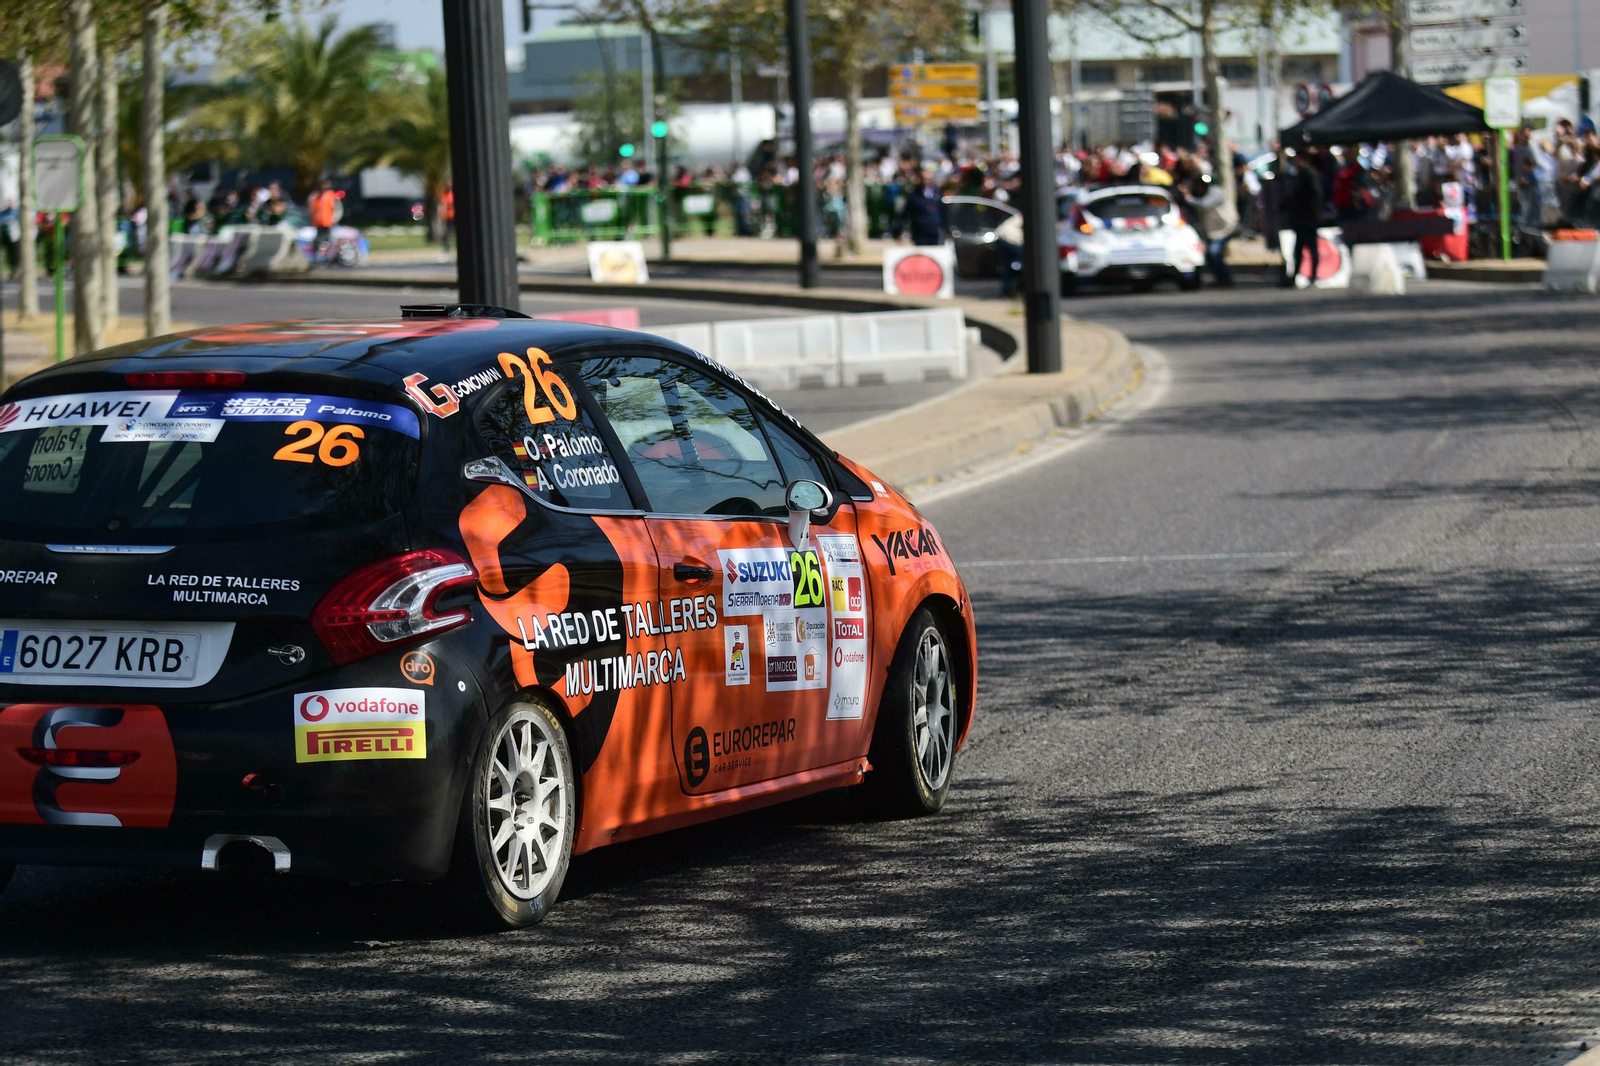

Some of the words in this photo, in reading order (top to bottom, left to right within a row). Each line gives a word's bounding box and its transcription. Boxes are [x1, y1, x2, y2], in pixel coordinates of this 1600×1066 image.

[497, 347, 577, 425] 26
[24, 401, 151, 422] HUAWEI
[317, 404, 392, 421] Palomo
[273, 420, 365, 467] 26
[523, 435, 547, 461] O.
[543, 432, 603, 459] Palomo
[536, 466, 555, 492] A.
[553, 459, 620, 489] Coronado
[738, 561, 791, 583] SUZUKI
[790, 551, 823, 607] 26
[147, 574, 165, 585] LA
[169, 575, 199, 586] RED
[202, 576, 222, 587] DE
[226, 576, 300, 591] TALLERES
[832, 580, 844, 591] RACC
[173, 590, 269, 605] MULTIMARCA
[516, 615, 549, 650] LA
[546, 612, 590, 648] RED
[591, 607, 621, 643] DE
[621, 594, 718, 639] TALLERES
[806, 620, 825, 631] Diputación
[836, 621, 863, 636] TOTAL
[3, 656, 11, 666] E
[20, 635, 107, 669] 6027
[115, 637, 184, 673] KRB
[843, 651, 864, 662] vodafone
[405, 660, 431, 674] dro
[565, 647, 687, 697] MULTIMARCA
[774, 661, 797, 672] IMDECO
[334, 698, 420, 715] vodafone
[306, 728, 415, 755] PIRELLI
[713, 718, 796, 757] EUROREPAR
[714, 762, 726, 773] CAR
[727, 757, 752, 771] SERVICE
